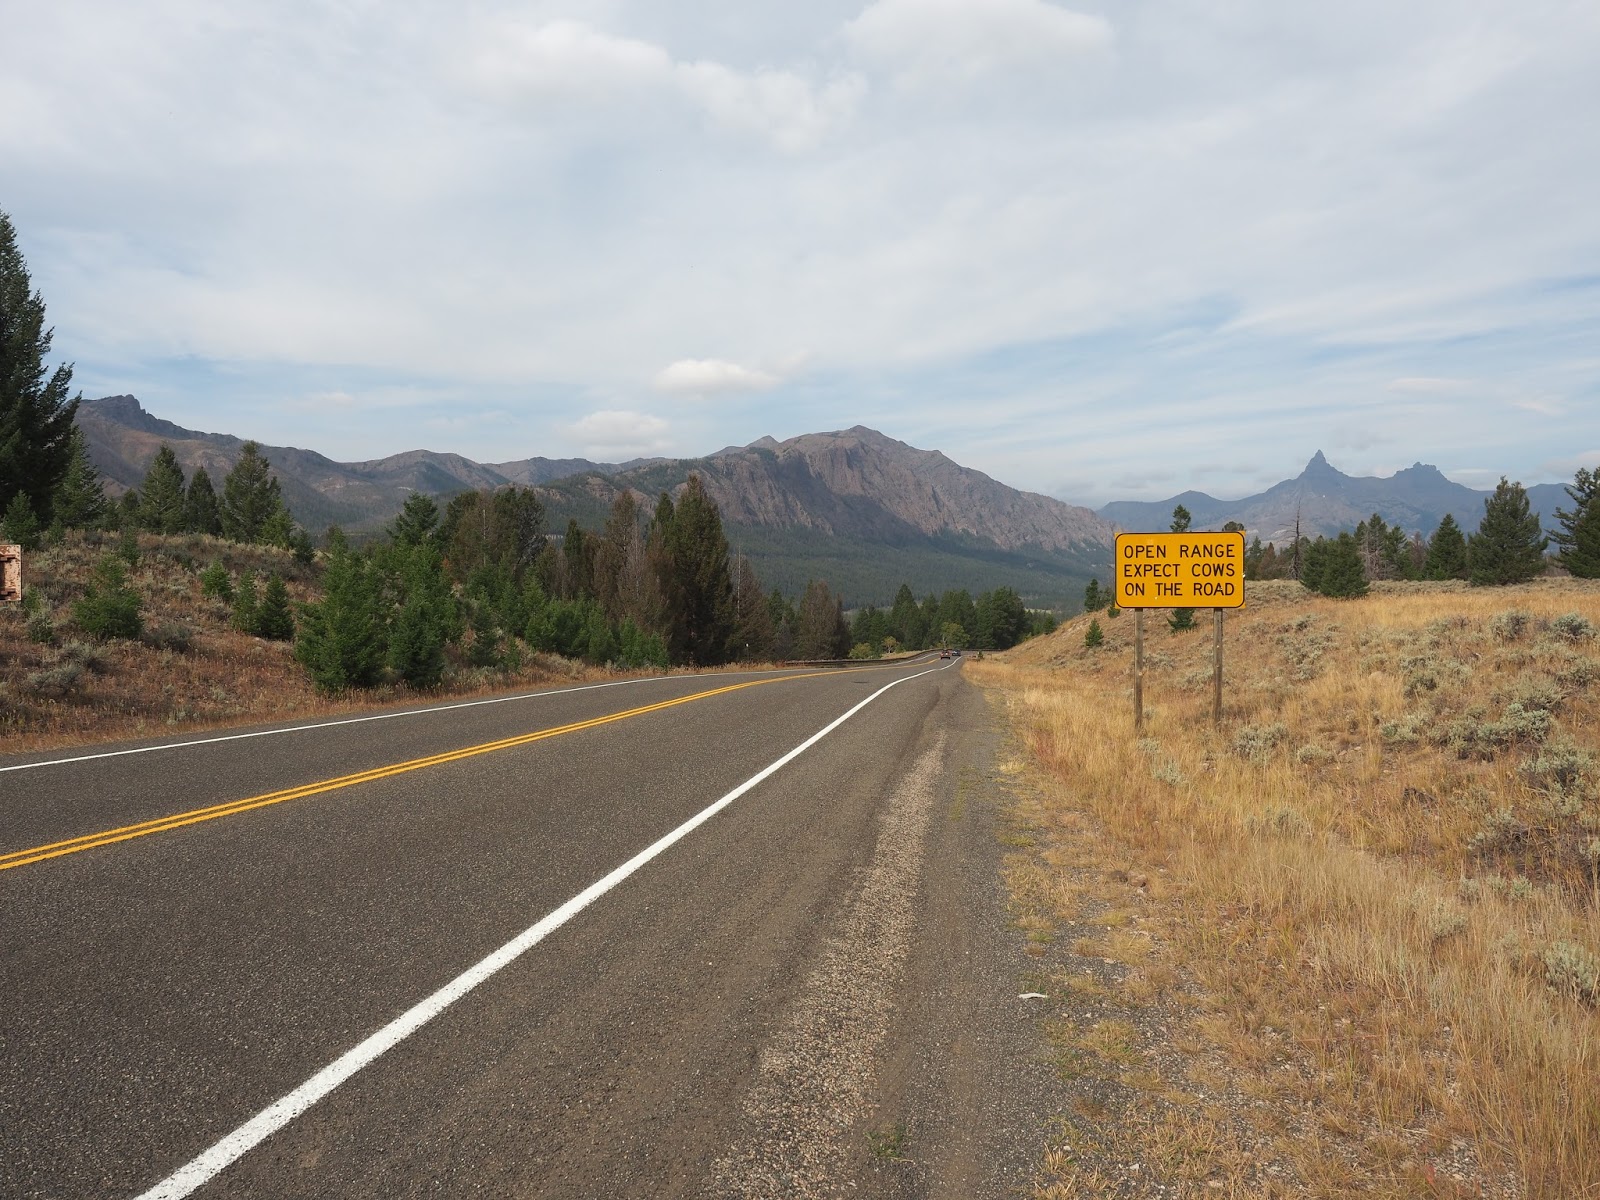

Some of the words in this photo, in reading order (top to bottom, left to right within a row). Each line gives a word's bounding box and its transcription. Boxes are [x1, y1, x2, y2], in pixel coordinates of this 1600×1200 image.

[1124, 545, 1166, 558] OPEN
[1180, 544, 1235, 558] RANGE
[1124, 564, 1180, 577] EXPECT
[1191, 563, 1235, 577] COWS
[1125, 583, 1145, 596] ON
[1155, 583, 1183, 596] THE
[1193, 583, 1235, 596] ROAD
